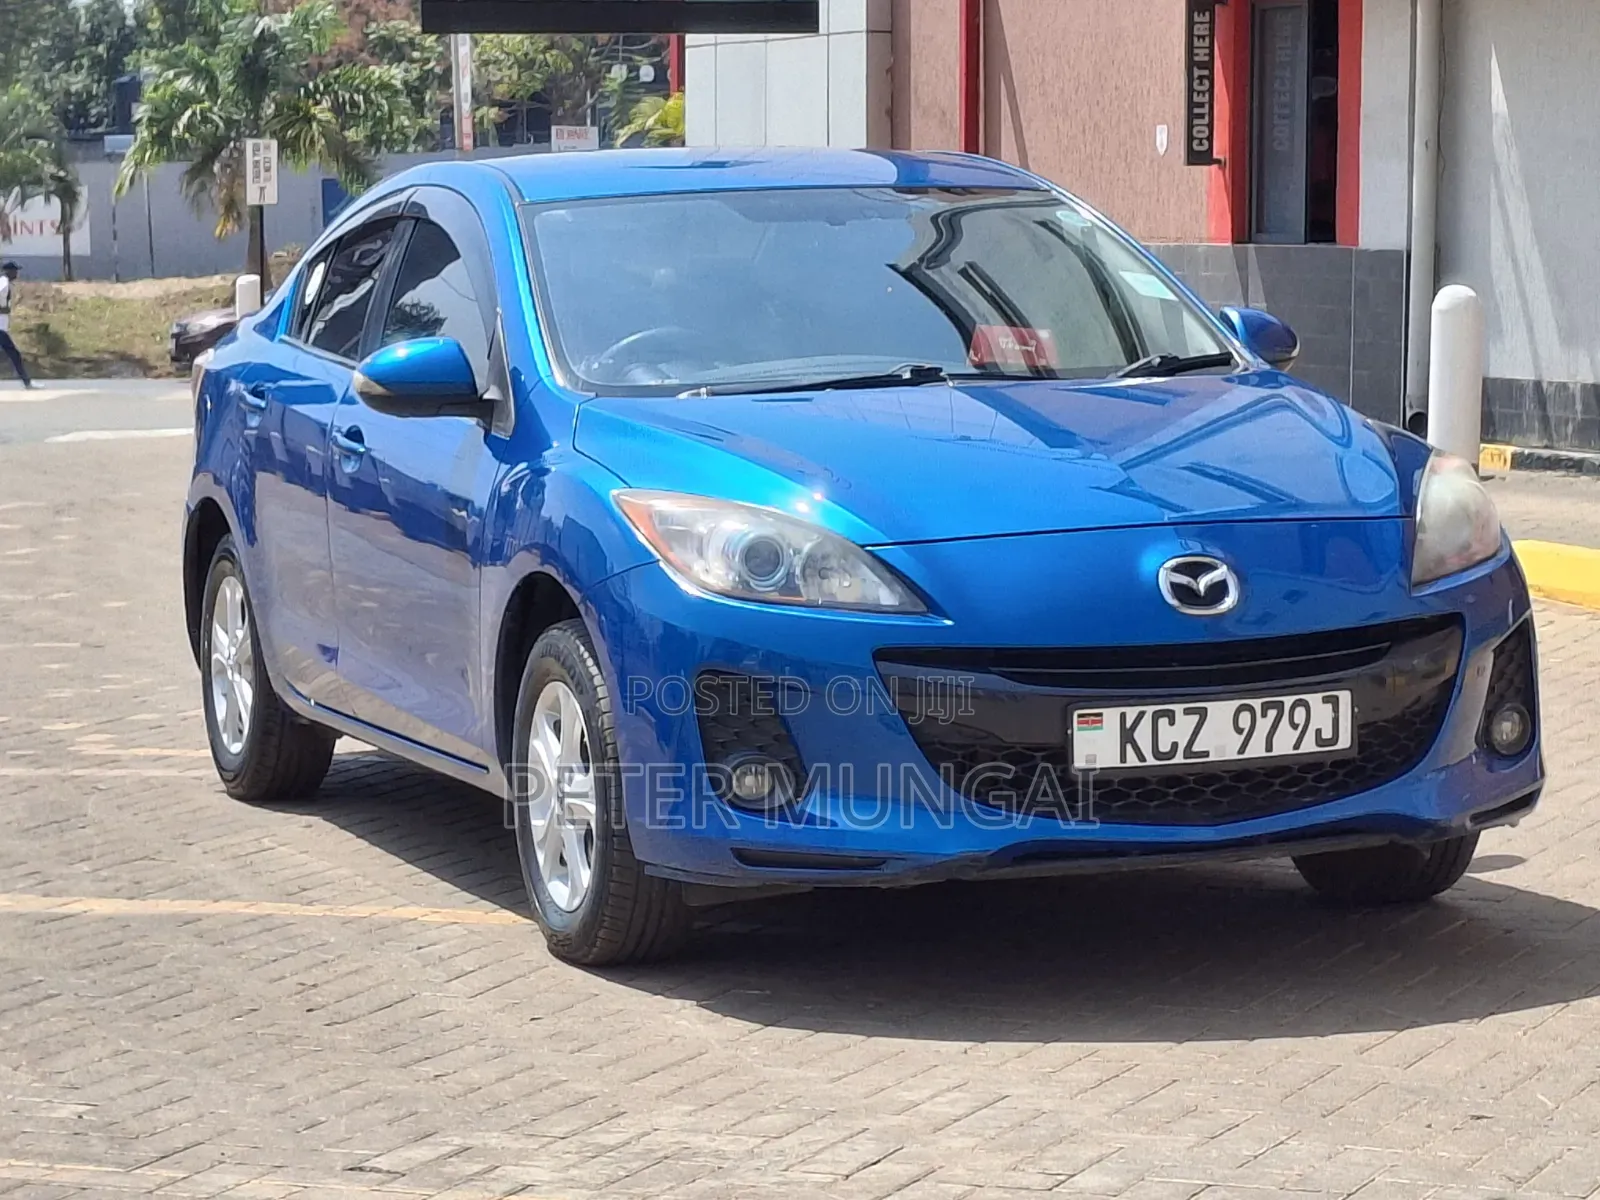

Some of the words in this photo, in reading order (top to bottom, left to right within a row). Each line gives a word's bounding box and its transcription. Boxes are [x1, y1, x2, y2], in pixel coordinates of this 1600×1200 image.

[1193, 11, 1211, 61] HERE
[1192, 66, 1210, 152] COLLECT
[1119, 705, 1210, 764] KCZ
[1232, 694, 1340, 755] 979J
